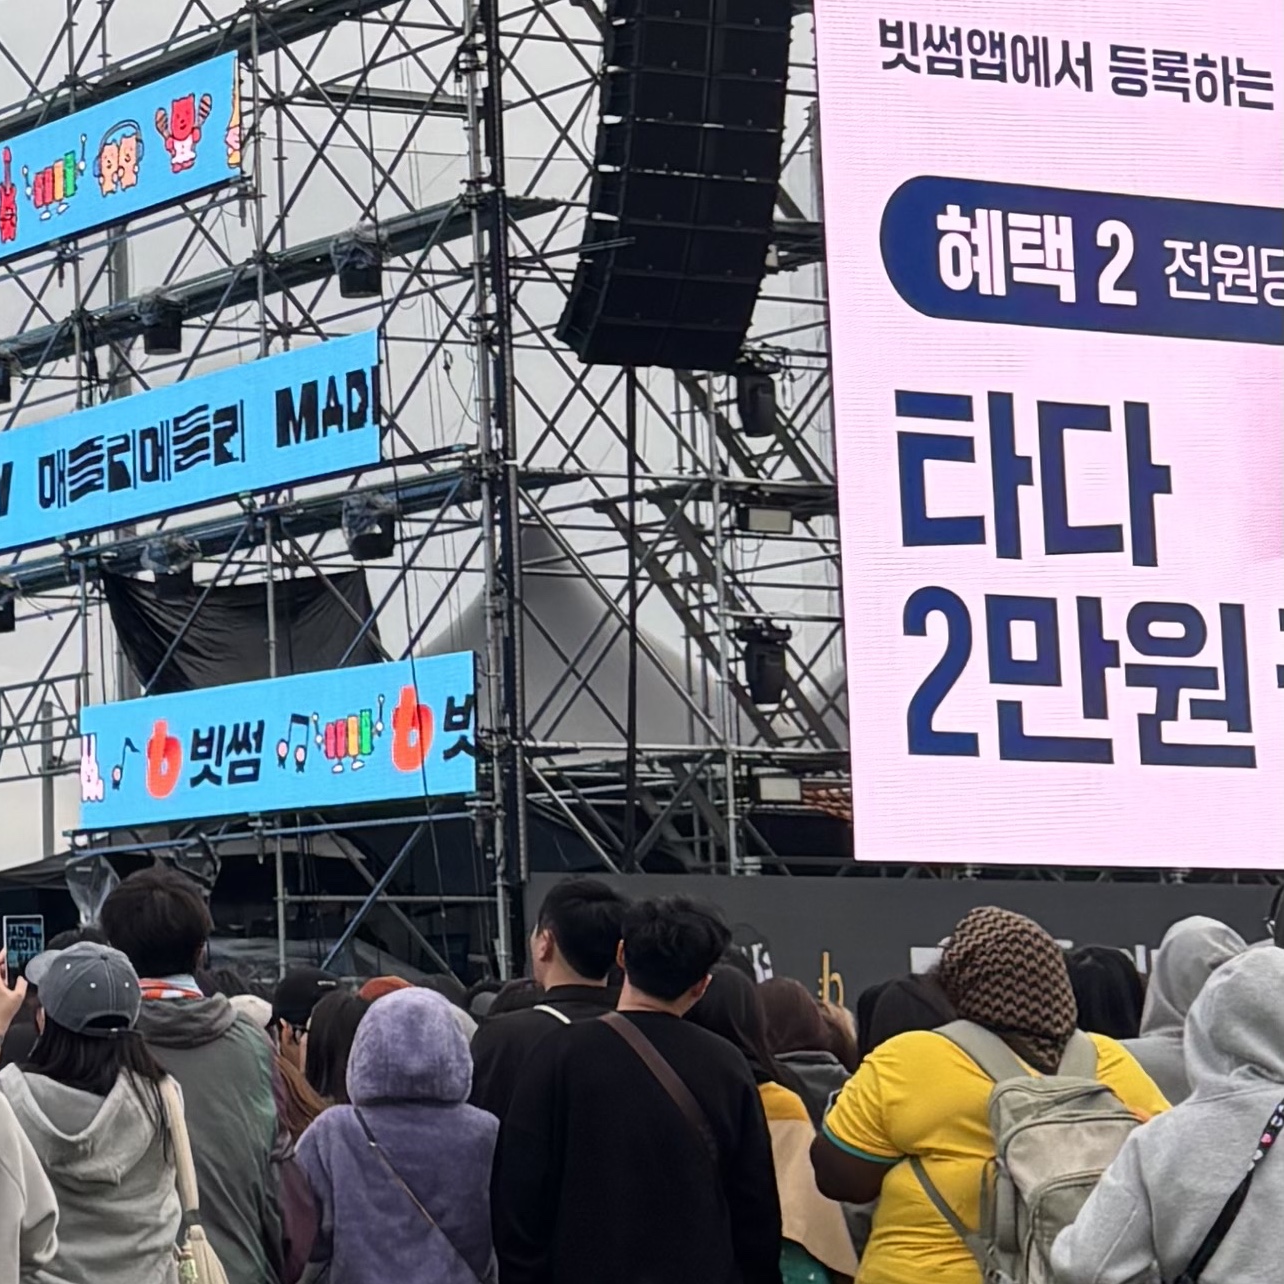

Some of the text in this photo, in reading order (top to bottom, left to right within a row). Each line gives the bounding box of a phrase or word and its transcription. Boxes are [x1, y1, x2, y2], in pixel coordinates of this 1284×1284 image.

[878, 18, 1274, 111] 빗썸앱에서 등록하는
[937, 204, 1076, 303] 혜택
[1096, 220, 1138, 306] 2
[894, 389, 1172, 568] 타다
[902, 585, 1257, 769] 2만원
[190, 719, 265, 788] 빗썸
